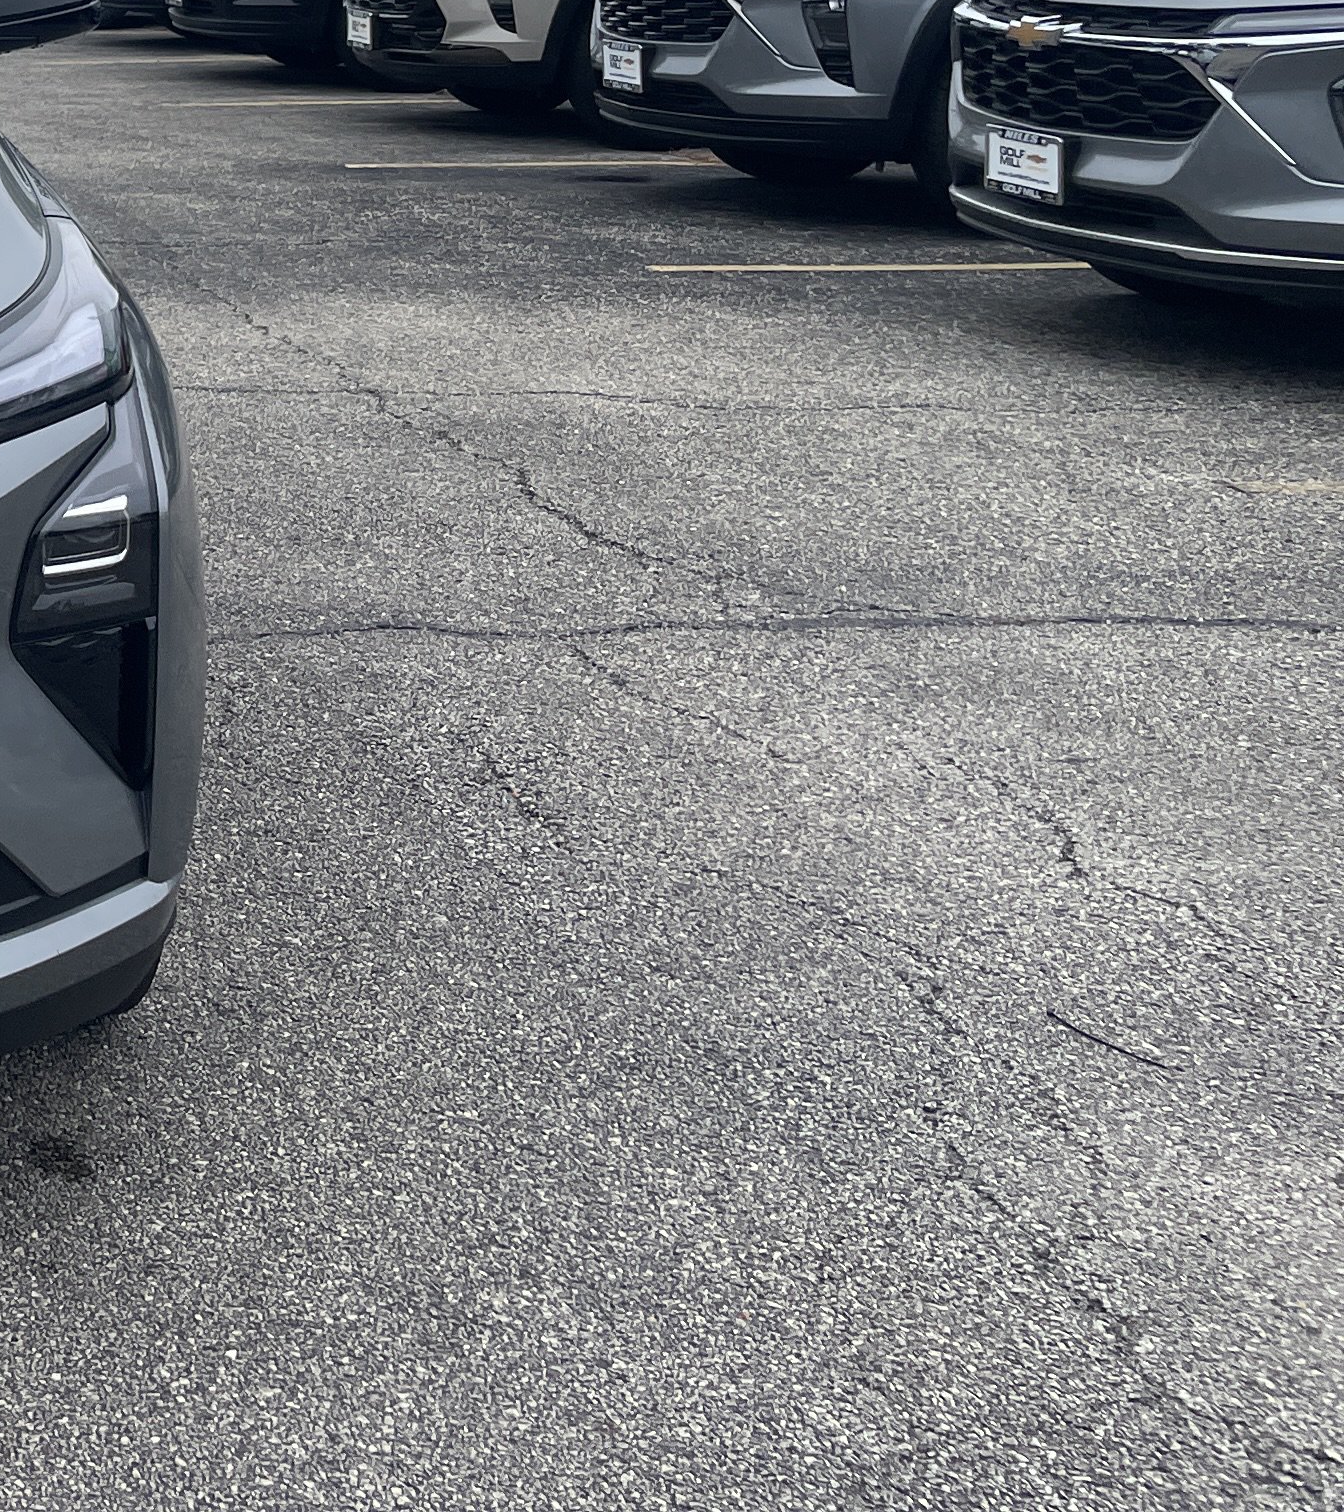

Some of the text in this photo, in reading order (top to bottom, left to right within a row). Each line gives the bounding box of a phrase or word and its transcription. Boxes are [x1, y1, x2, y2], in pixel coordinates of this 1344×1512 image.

[1004, 129, 1040, 144] NILES
[1000, 146, 1025, 158] GOLF
[1000, 155, 1021, 168] MILL
[1002, 183, 1042, 200] GOLF MILL
